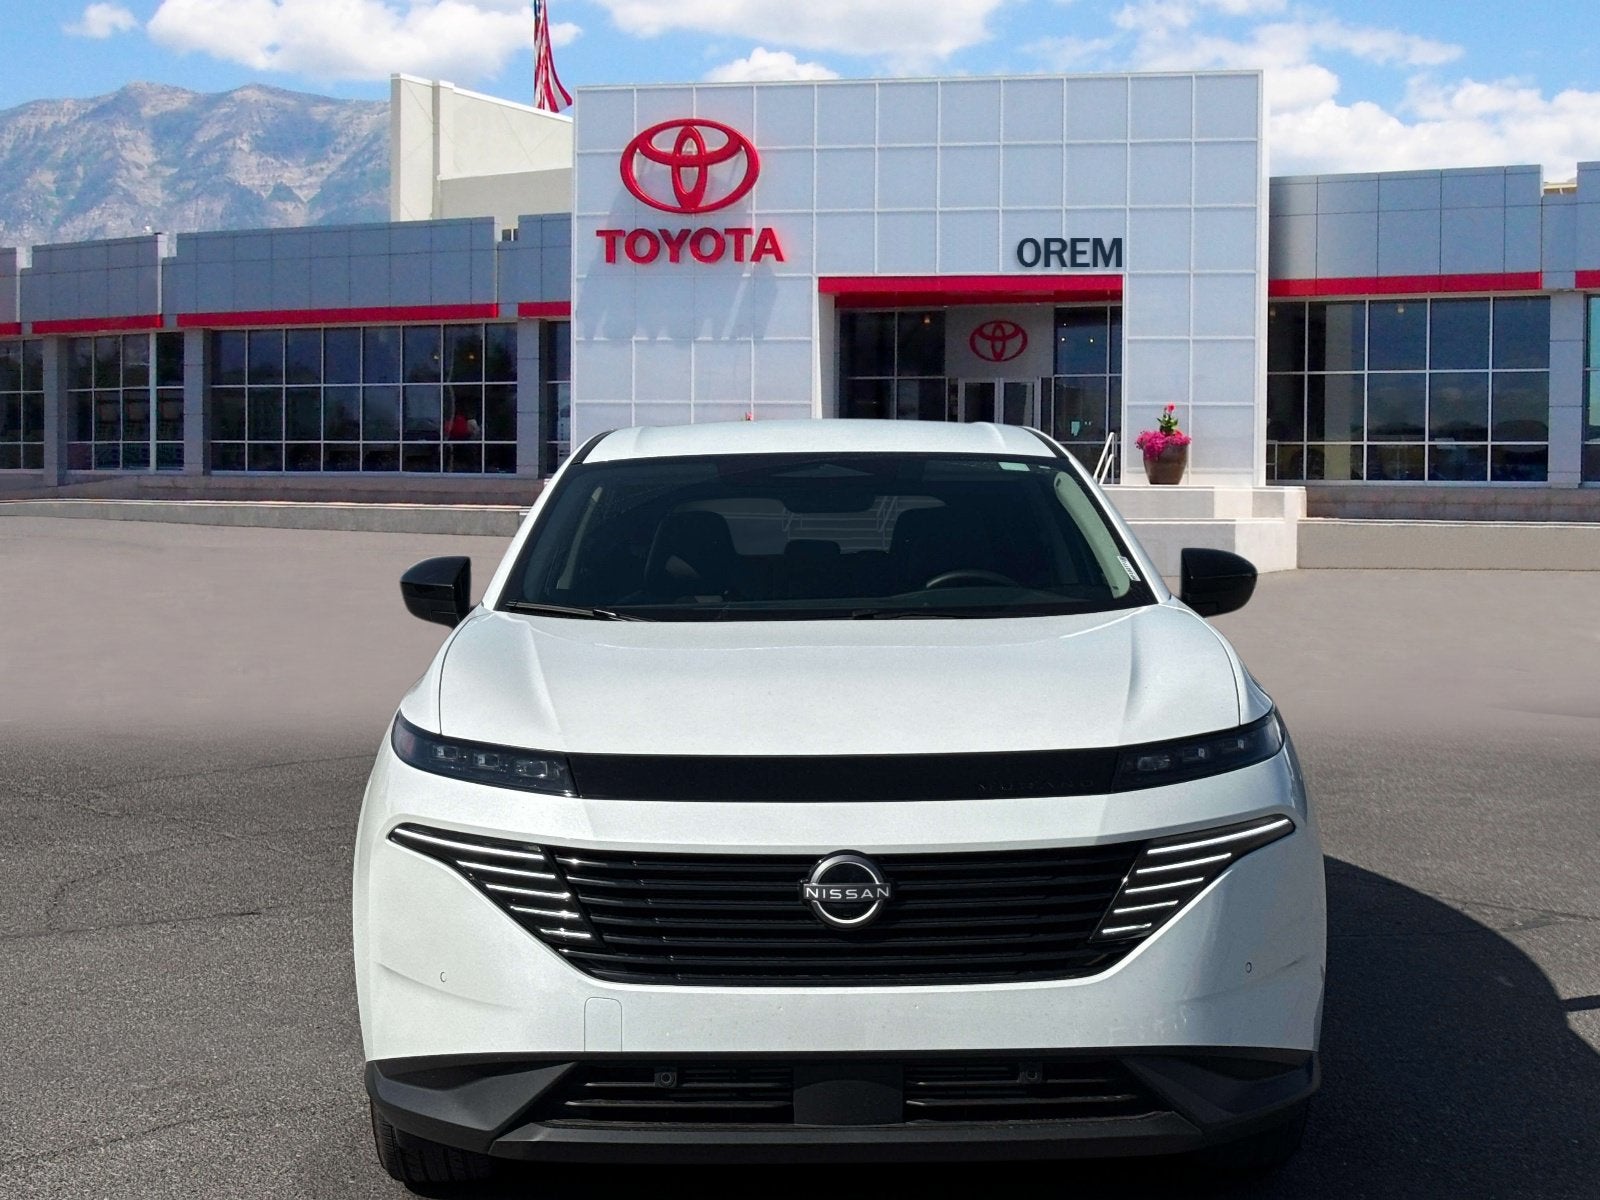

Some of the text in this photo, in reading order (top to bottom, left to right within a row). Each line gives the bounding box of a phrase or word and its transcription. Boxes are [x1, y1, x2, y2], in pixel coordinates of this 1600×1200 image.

[596, 227, 785, 264] TOYOTA
[1017, 237, 1123, 268] OREM
[806, 887, 890, 899] NISSAN
